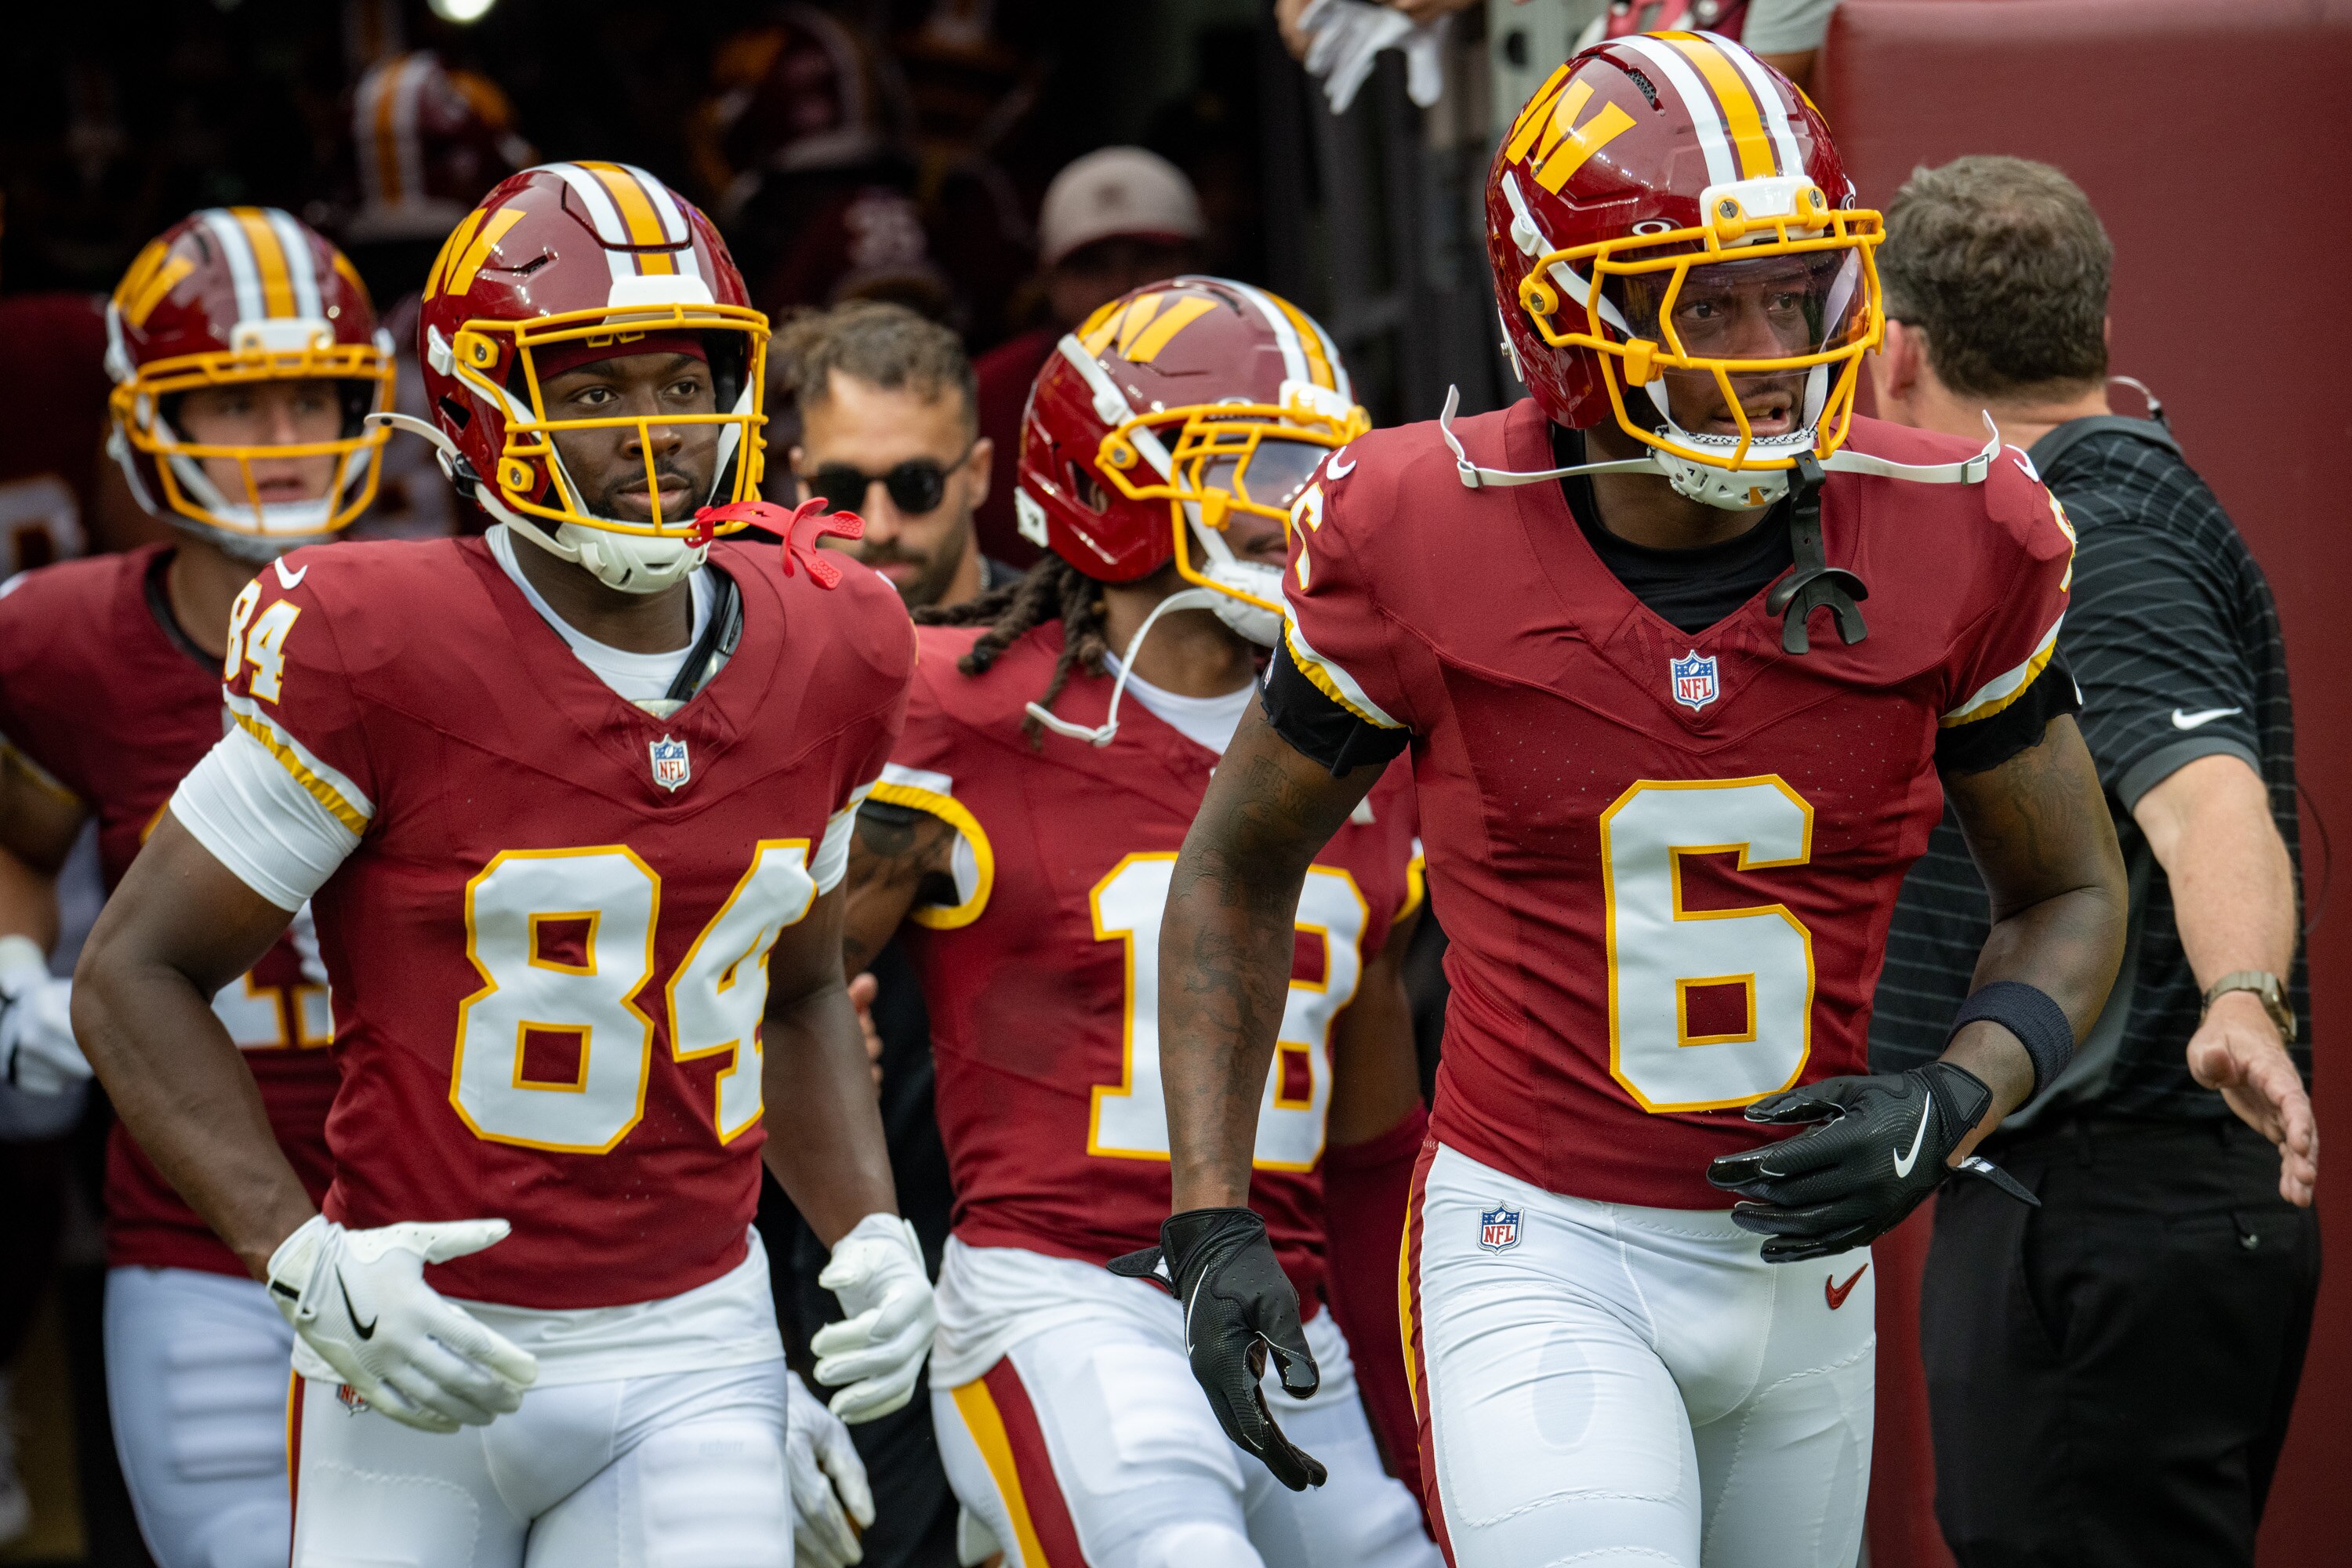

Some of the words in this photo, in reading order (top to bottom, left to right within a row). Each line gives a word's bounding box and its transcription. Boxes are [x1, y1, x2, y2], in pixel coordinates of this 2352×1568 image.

[224, 578, 302, 706] 84
[1679, 677, 1712, 700] NFL
[659, 760, 684, 782] NFL
[1599, 773, 1815, 1114] 6
[448, 837, 818, 1156] 84
[1483, 1225, 1514, 1245] NFL
